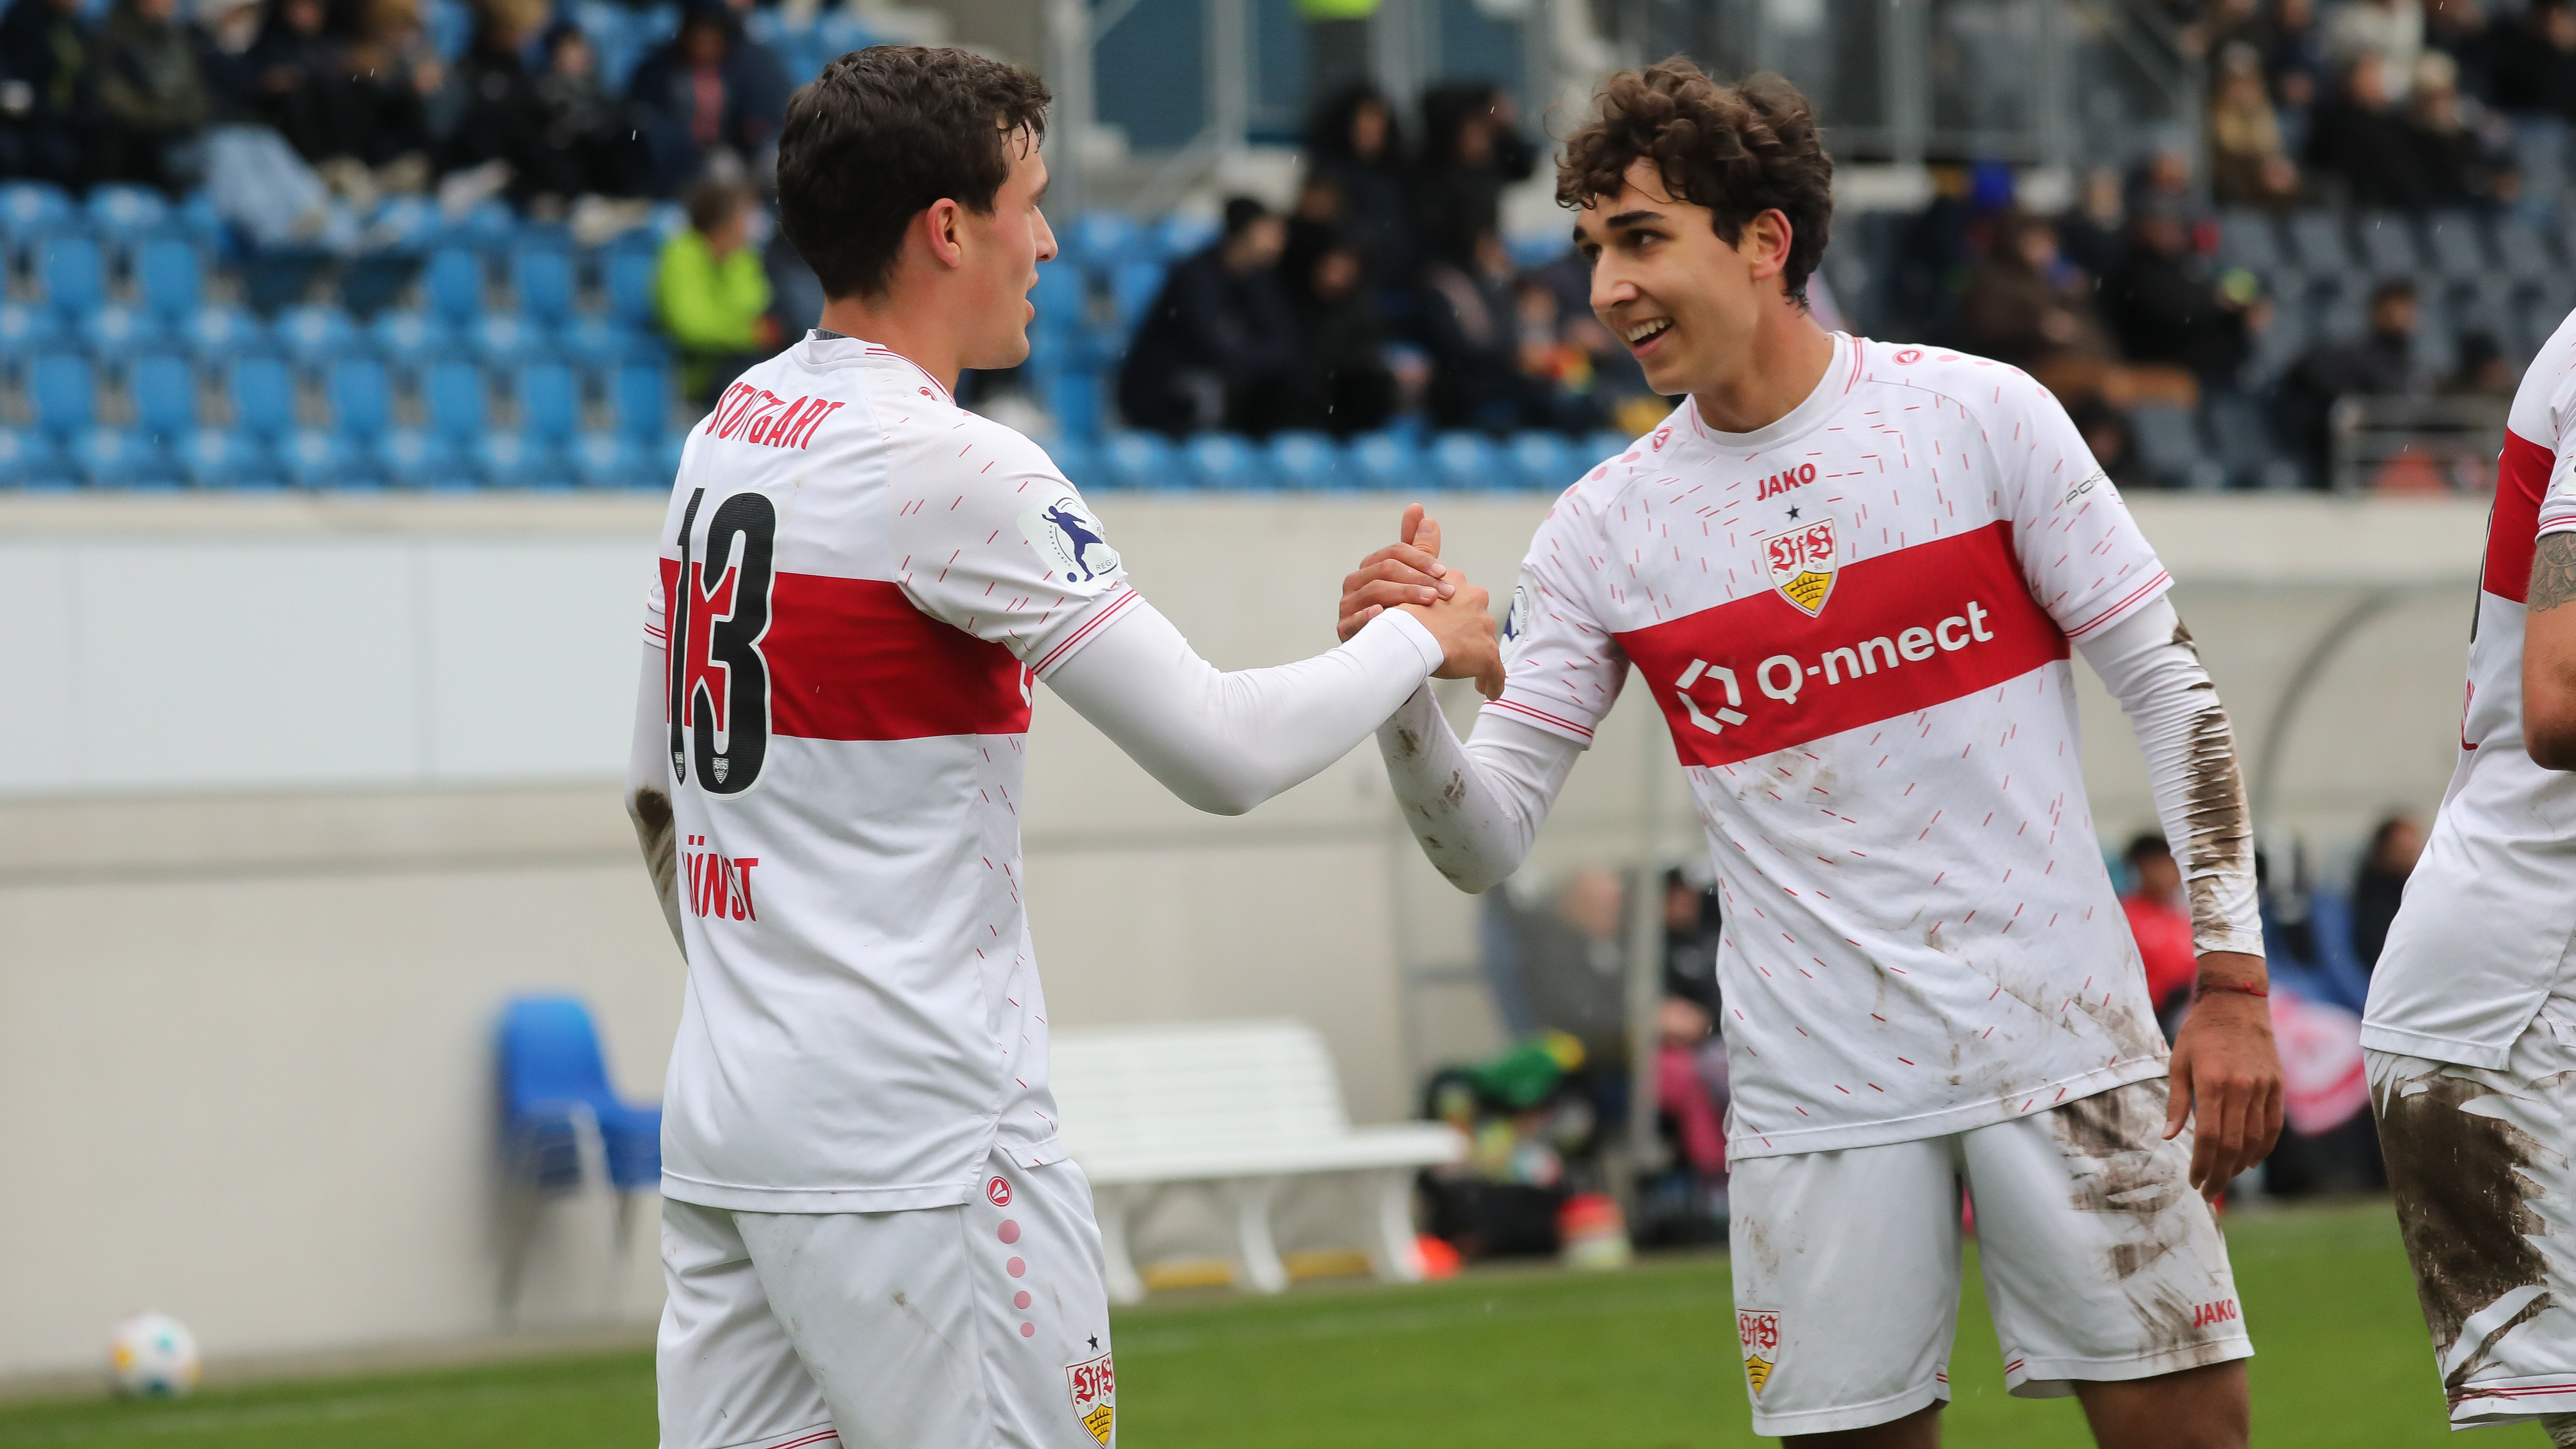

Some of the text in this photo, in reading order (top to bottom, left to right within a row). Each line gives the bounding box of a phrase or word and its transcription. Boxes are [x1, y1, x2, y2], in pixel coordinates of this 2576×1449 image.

[1756, 463, 1816, 501] JAKO
[670, 486, 777, 796] 13
[1756, 601, 1994, 704] Q-nnect
[681, 835, 759, 921] ÜNST
[2193, 1299, 2236, 1327] JAKO
